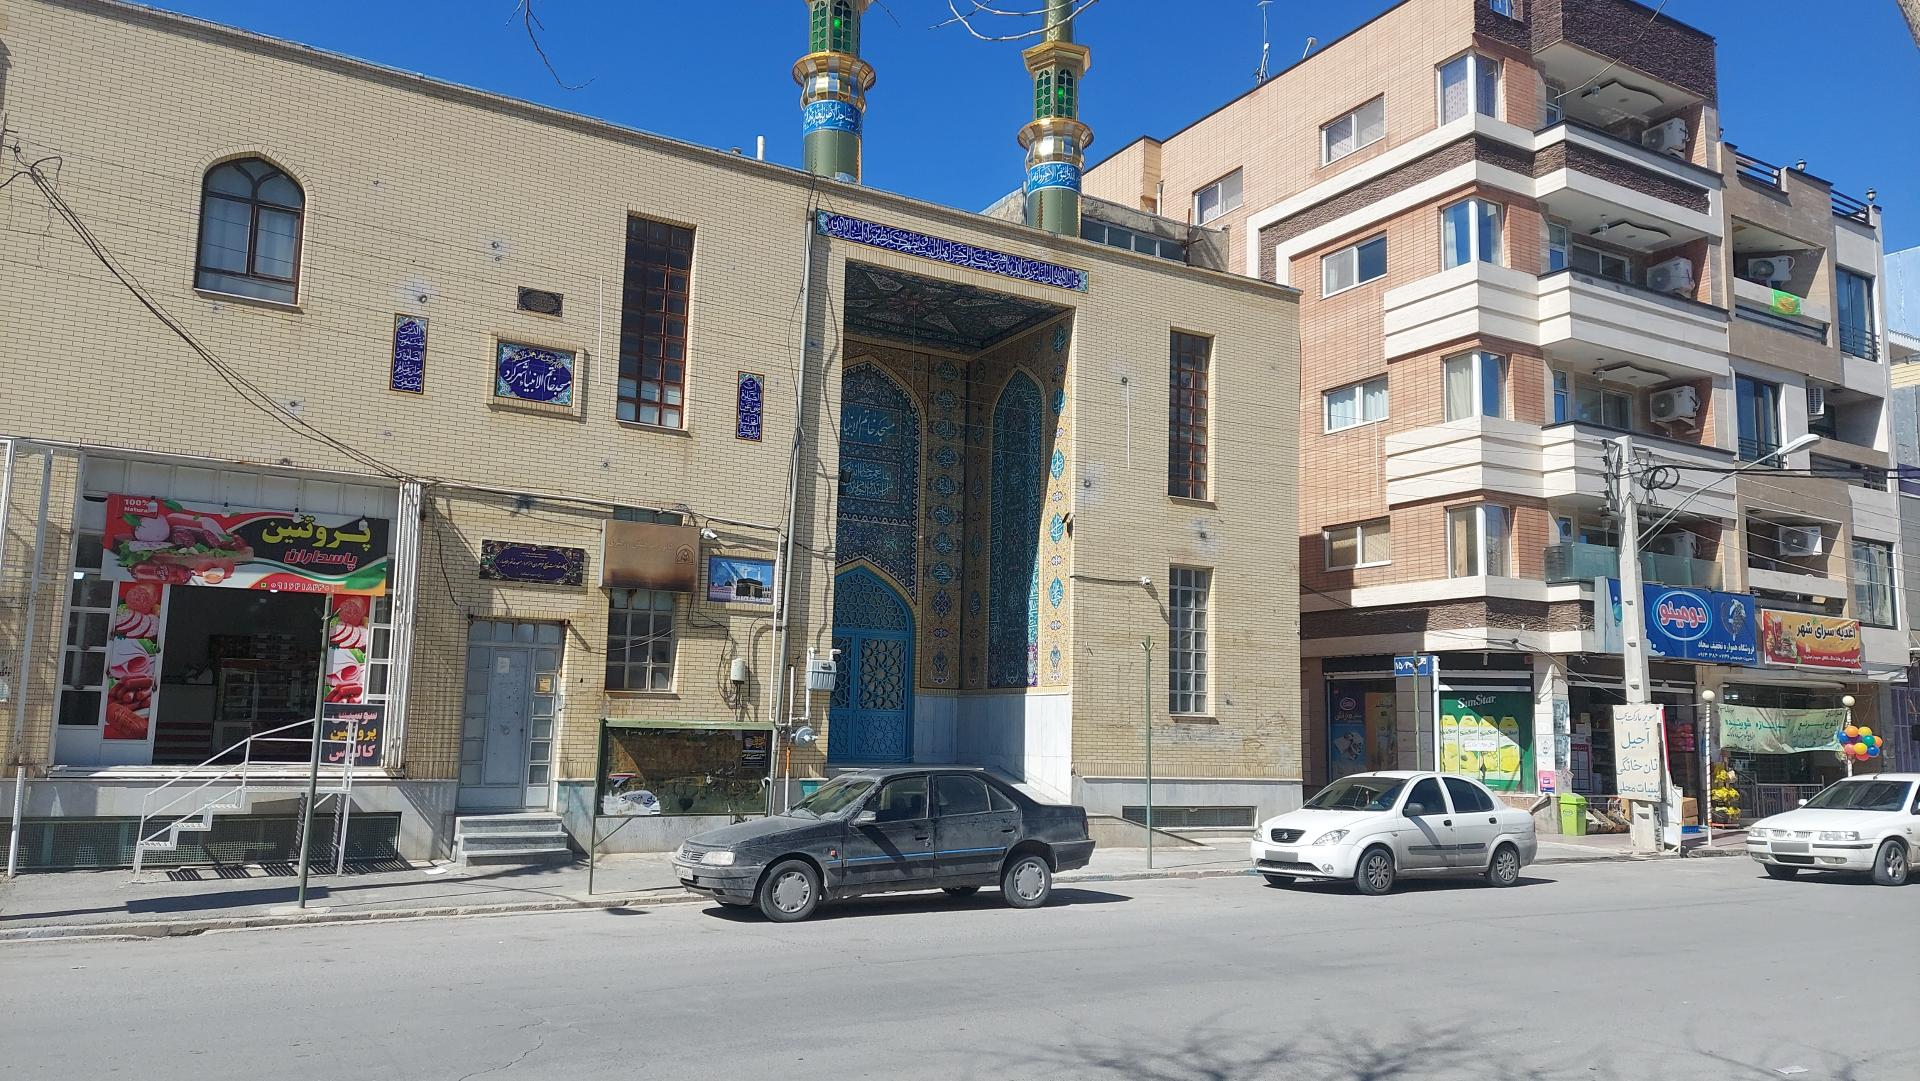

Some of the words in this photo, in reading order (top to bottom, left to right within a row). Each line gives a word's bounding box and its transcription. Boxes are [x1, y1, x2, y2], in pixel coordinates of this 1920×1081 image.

[555, 379, 571, 395] مسجد
[284, 548, 359, 572] پاسداران
[1796, 621, 1814, 638] شهر
[1815, 625, 1836, 640] سرای
[1457, 695, 1497, 709] SunStar
[1621, 727, 1651, 750] آجیل
[1616, 755, 1644, 776] خانگی
[1643, 758, 1659, 774] نان
